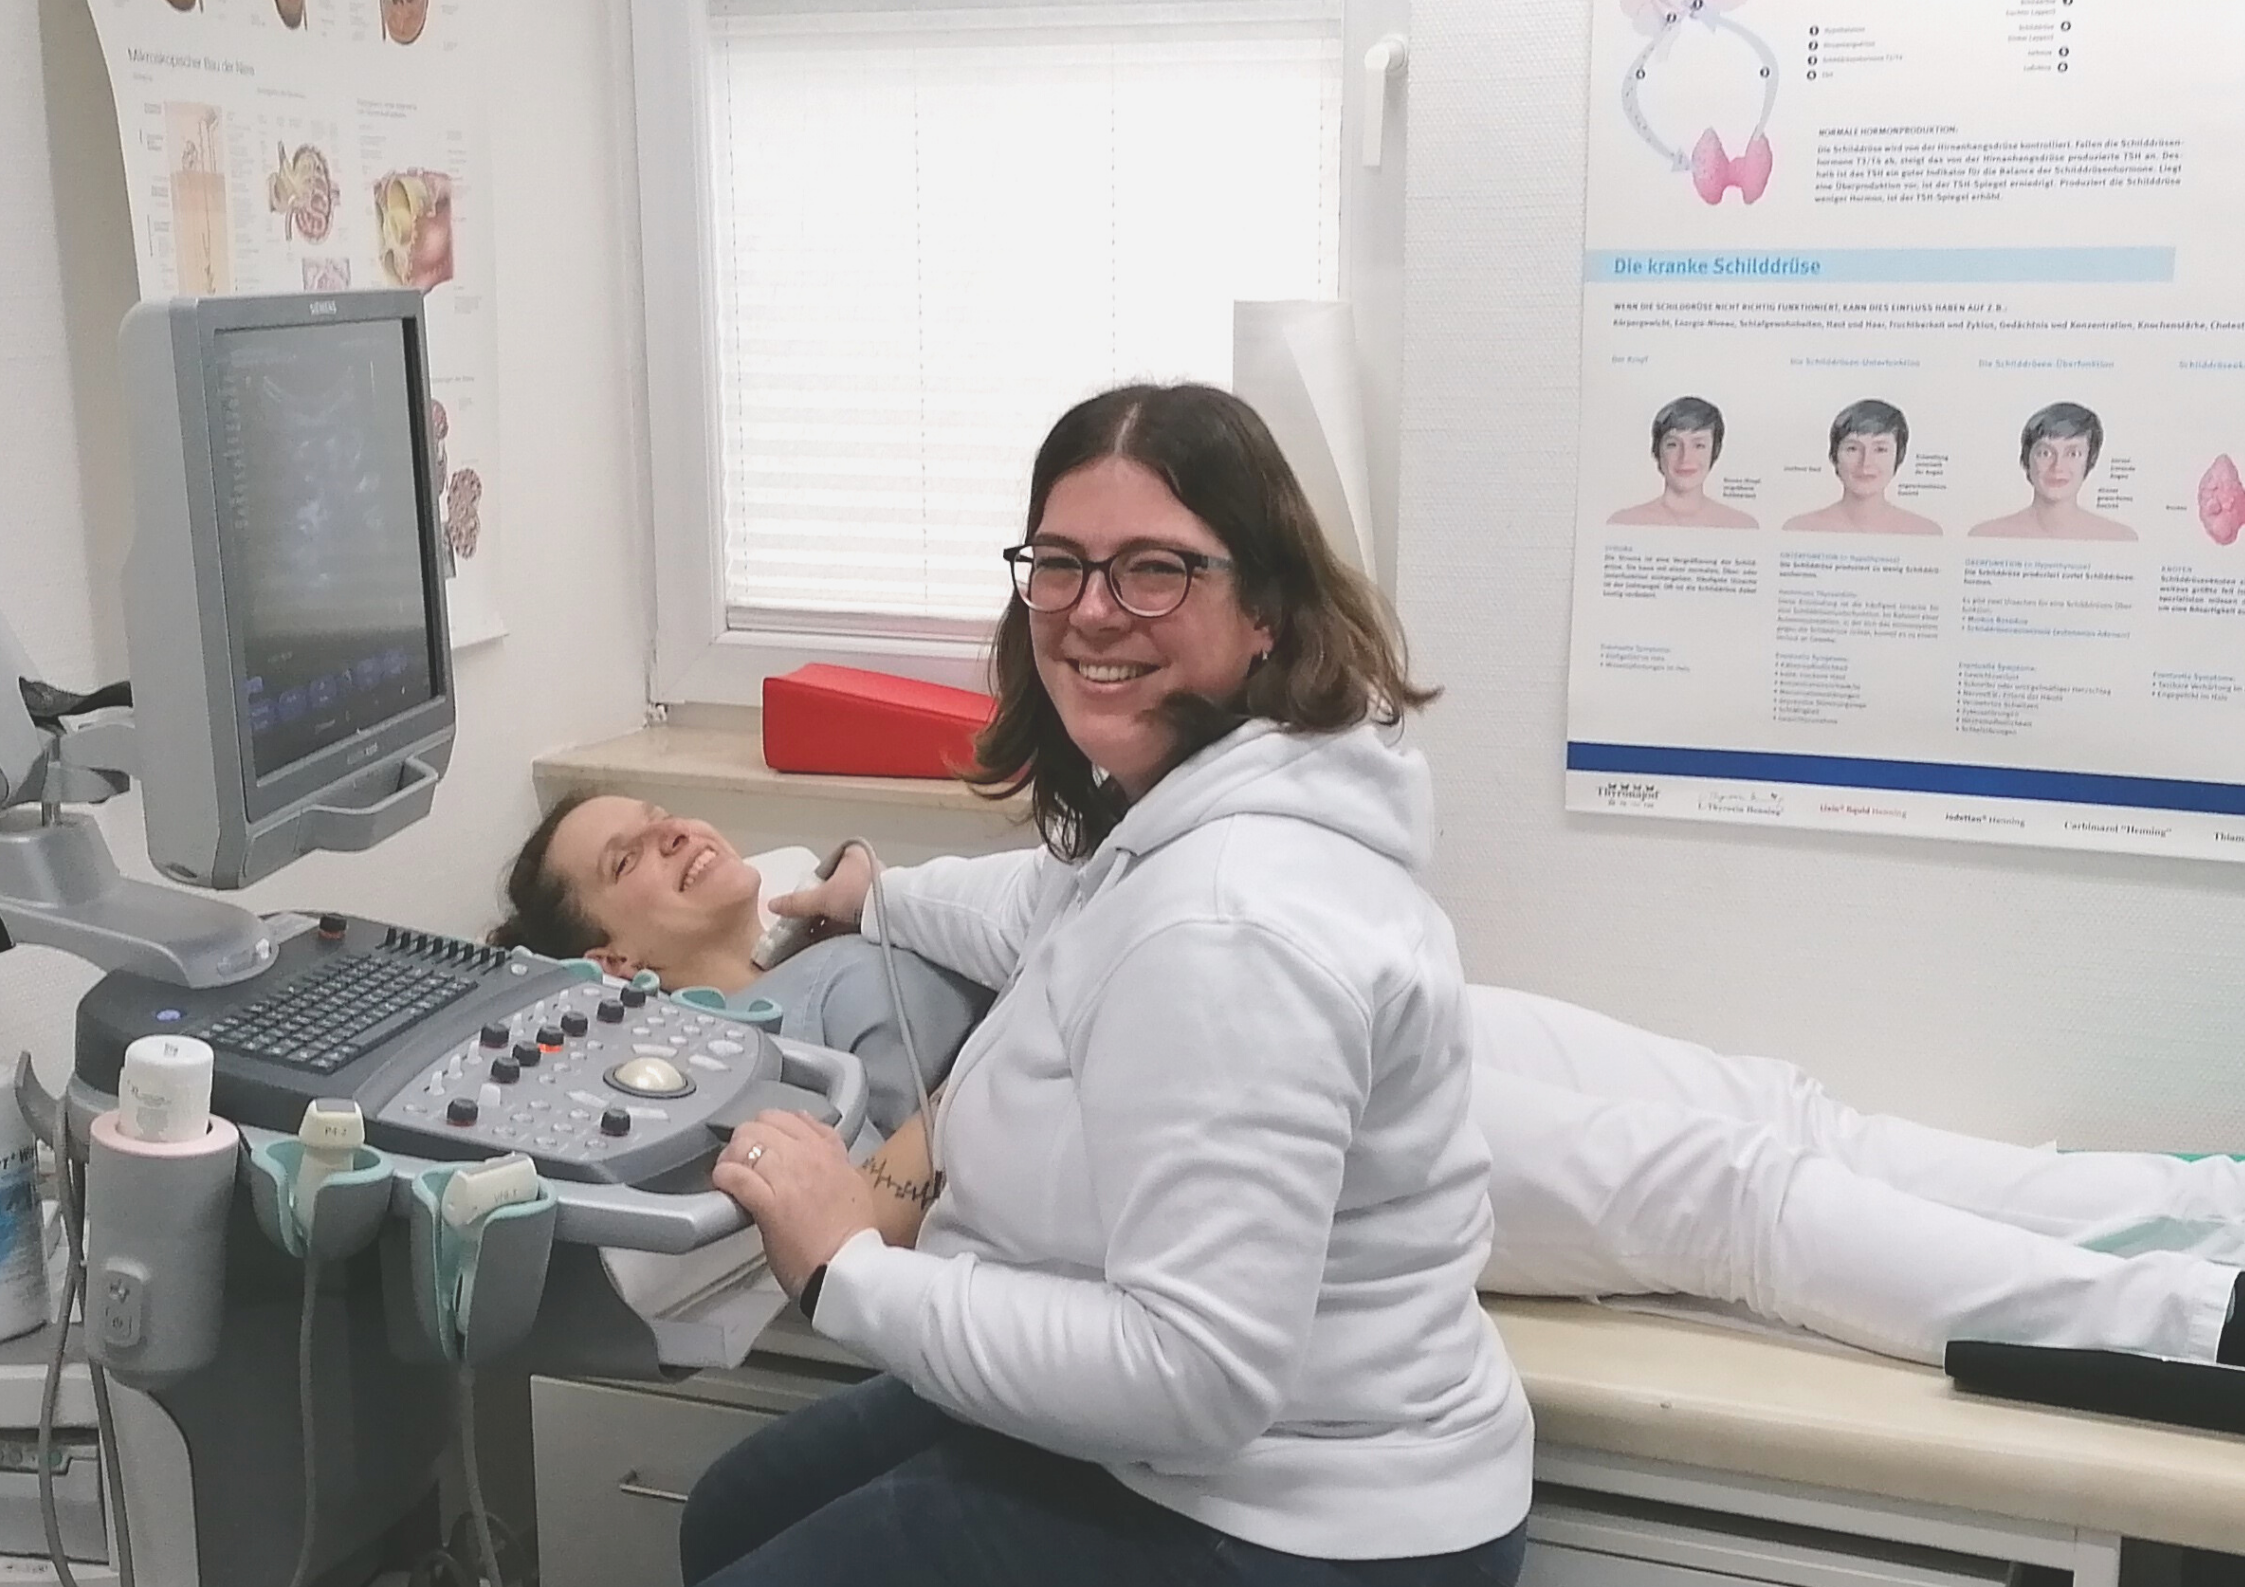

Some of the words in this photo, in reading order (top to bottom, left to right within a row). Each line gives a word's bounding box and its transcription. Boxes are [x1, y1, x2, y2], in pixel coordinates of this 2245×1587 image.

[1614, 257, 1642, 275] Die
[1648, 257, 1708, 275] kranke
[1713, 257, 1821, 275] Schilddrüse
